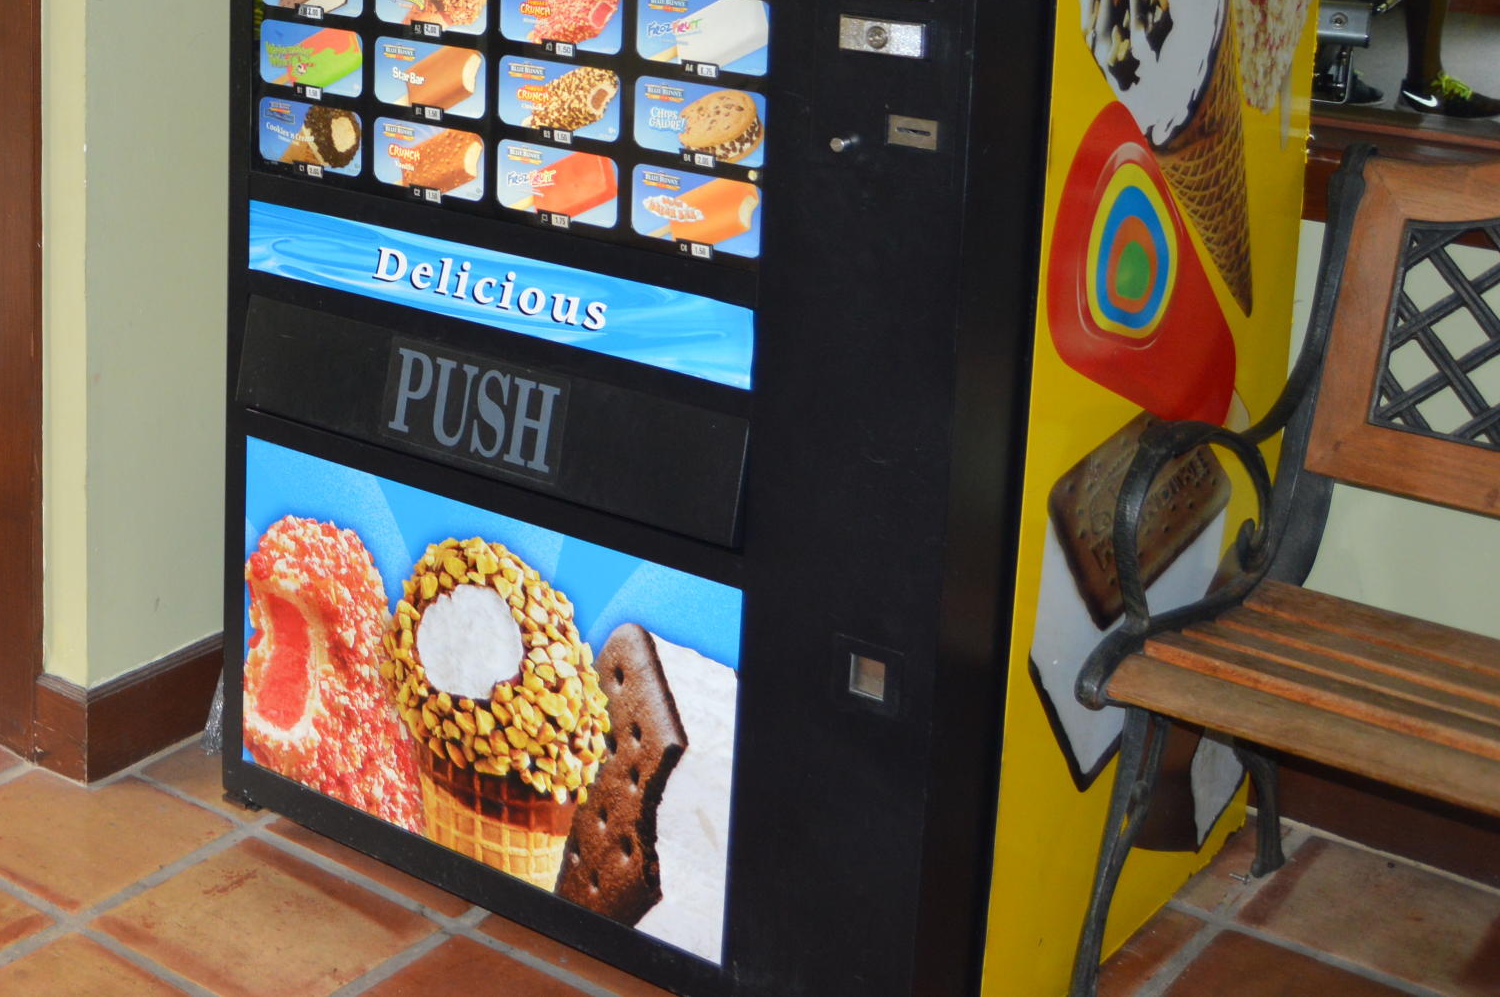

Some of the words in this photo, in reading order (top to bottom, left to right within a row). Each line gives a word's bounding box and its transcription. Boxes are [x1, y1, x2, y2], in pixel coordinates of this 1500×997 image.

[520, 3, 551, 17] CRUNCH
[517, 88, 549, 102] CRUNCH
[266, 121, 290, 137] Cookies
[295, 133, 315, 142] Cream
[388, 144, 421, 161] CRUNCH
[372, 246, 608, 331] Delicious
[387, 347, 562, 474] PUSH
